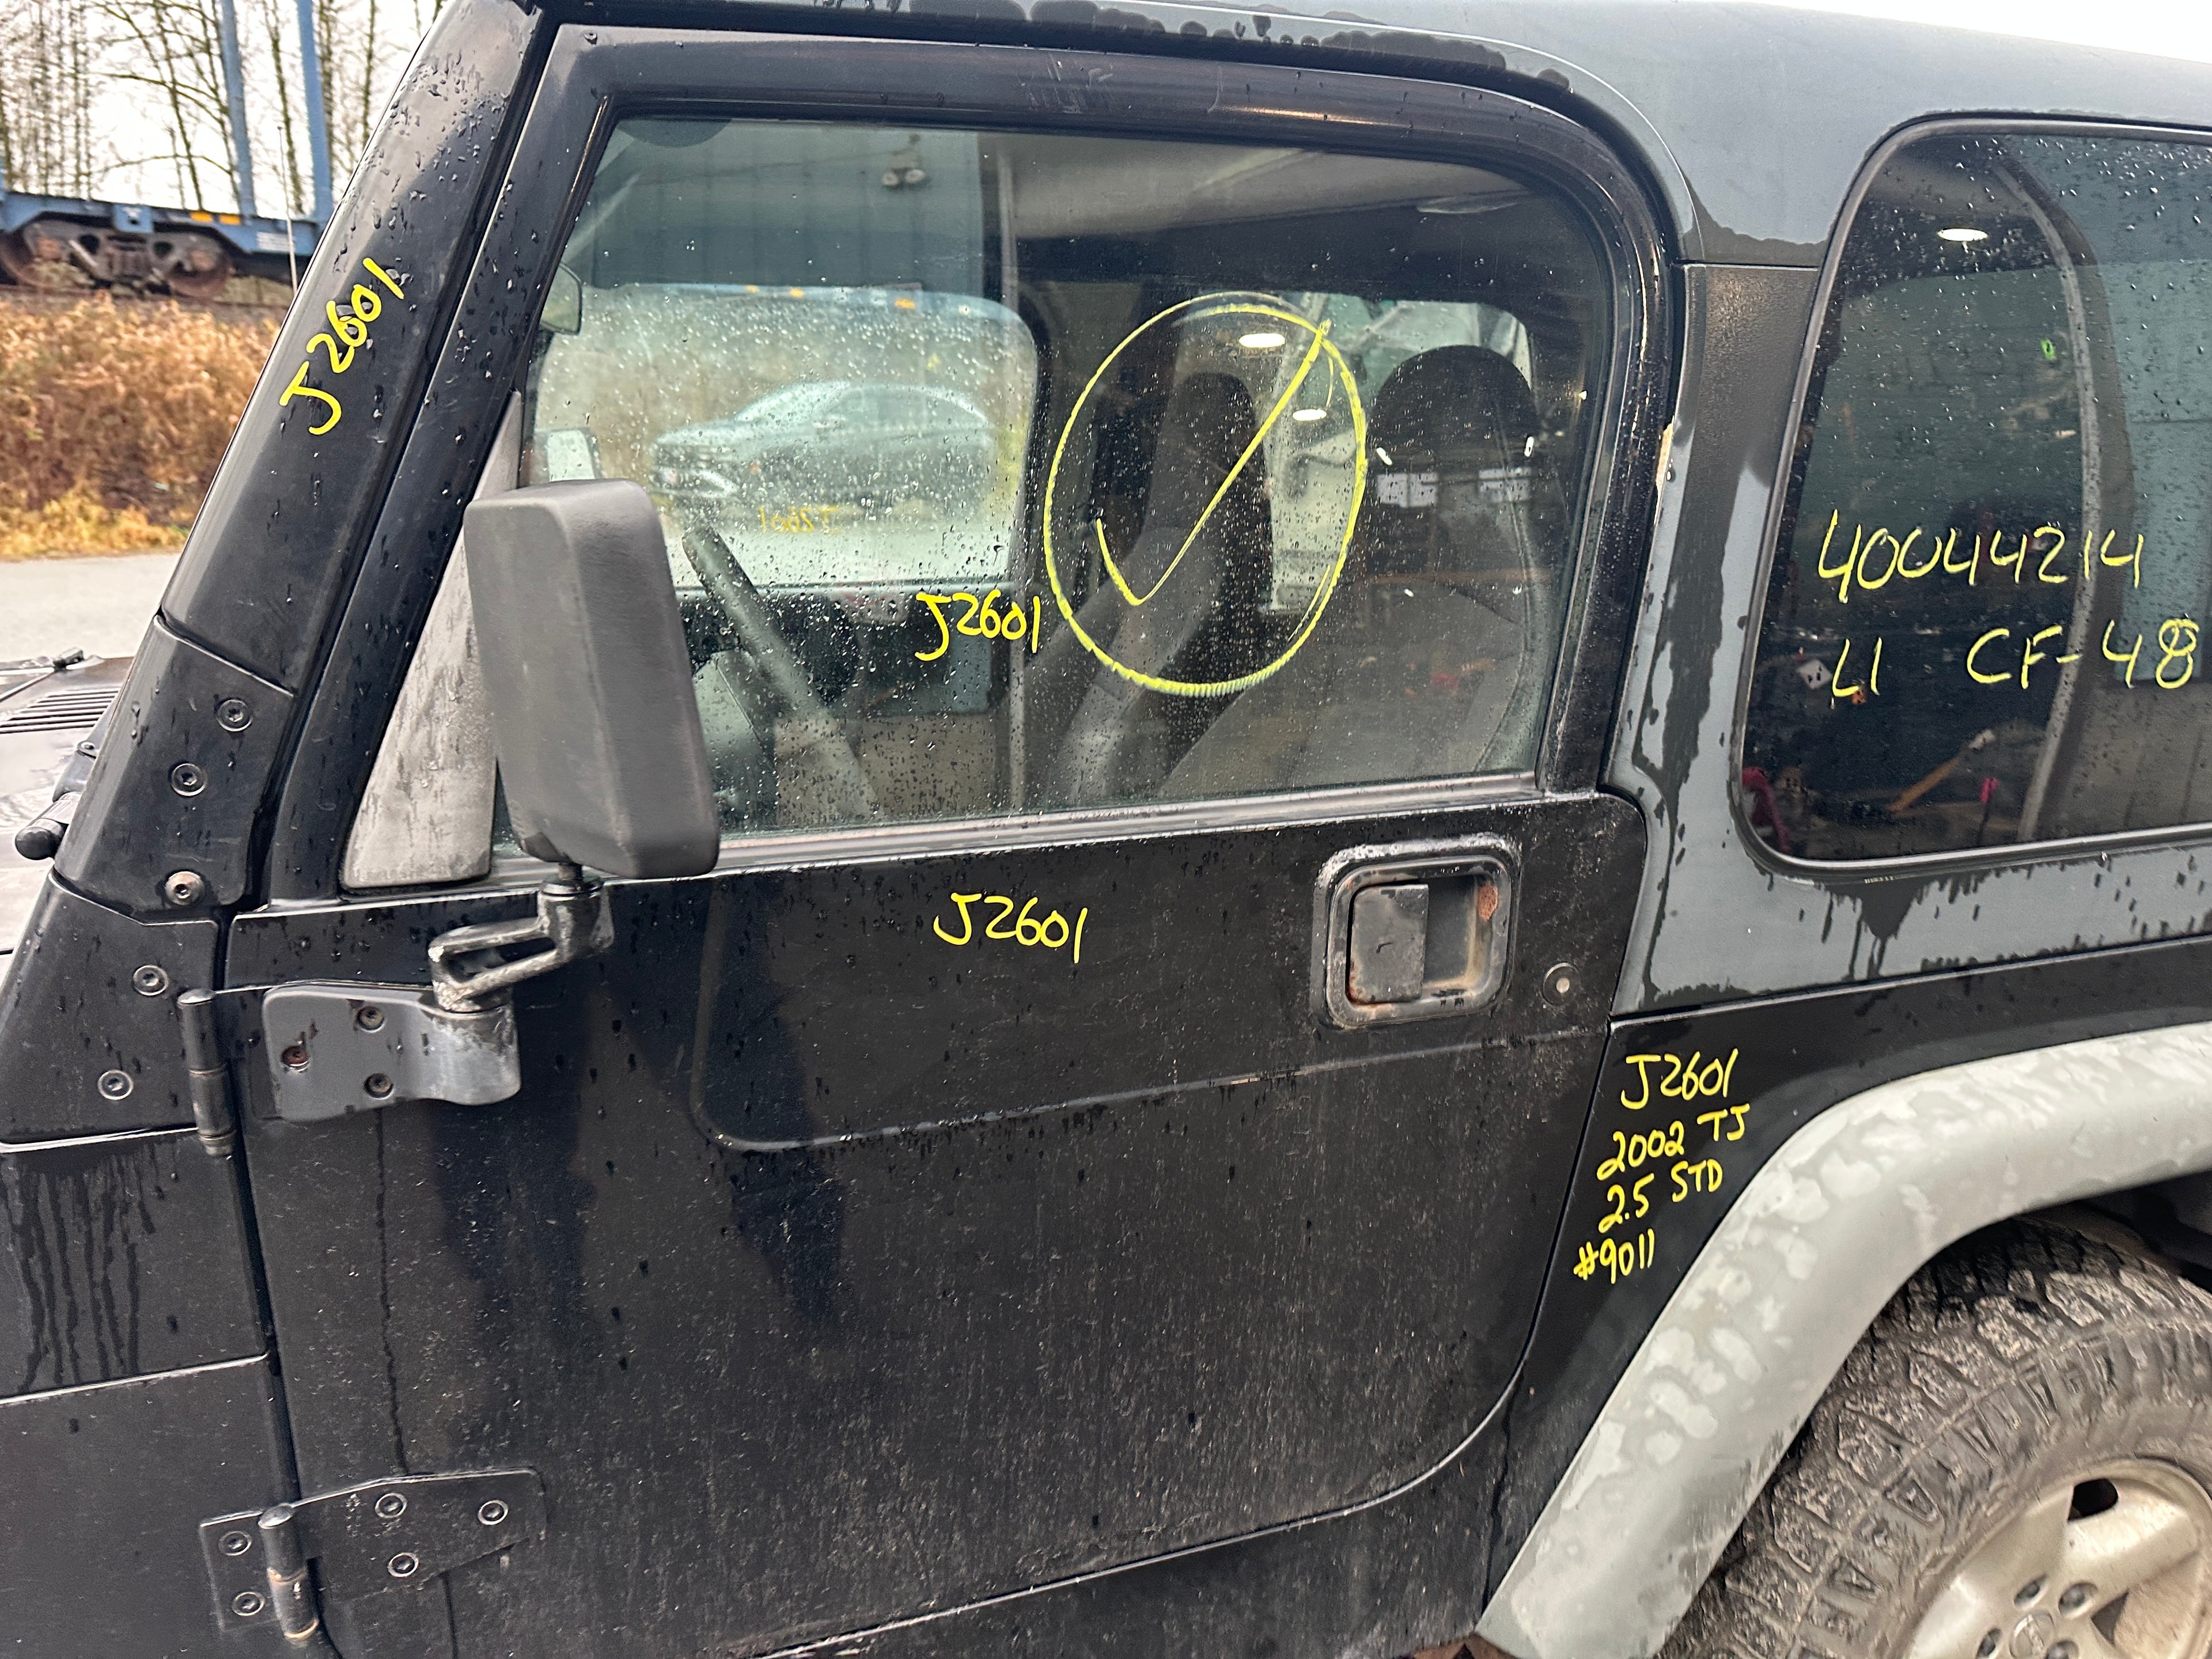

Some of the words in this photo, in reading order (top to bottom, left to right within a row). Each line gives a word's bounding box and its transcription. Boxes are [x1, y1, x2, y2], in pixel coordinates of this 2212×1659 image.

[279, 257, 404, 435] J2601
[915, 588, 1041, 662] J2601
[933, 892, 1089, 964] J2601
[1620, 1048, 1738, 1110] J2601
[1596, 1120, 1684, 1181] 2002
[1696, 1103, 1750, 1141] TJ
[1599, 1173, 1655, 1234] 2.5
[1670, 1159, 1723, 1202] STD
[1573, 1228, 1656, 1284] #9011
